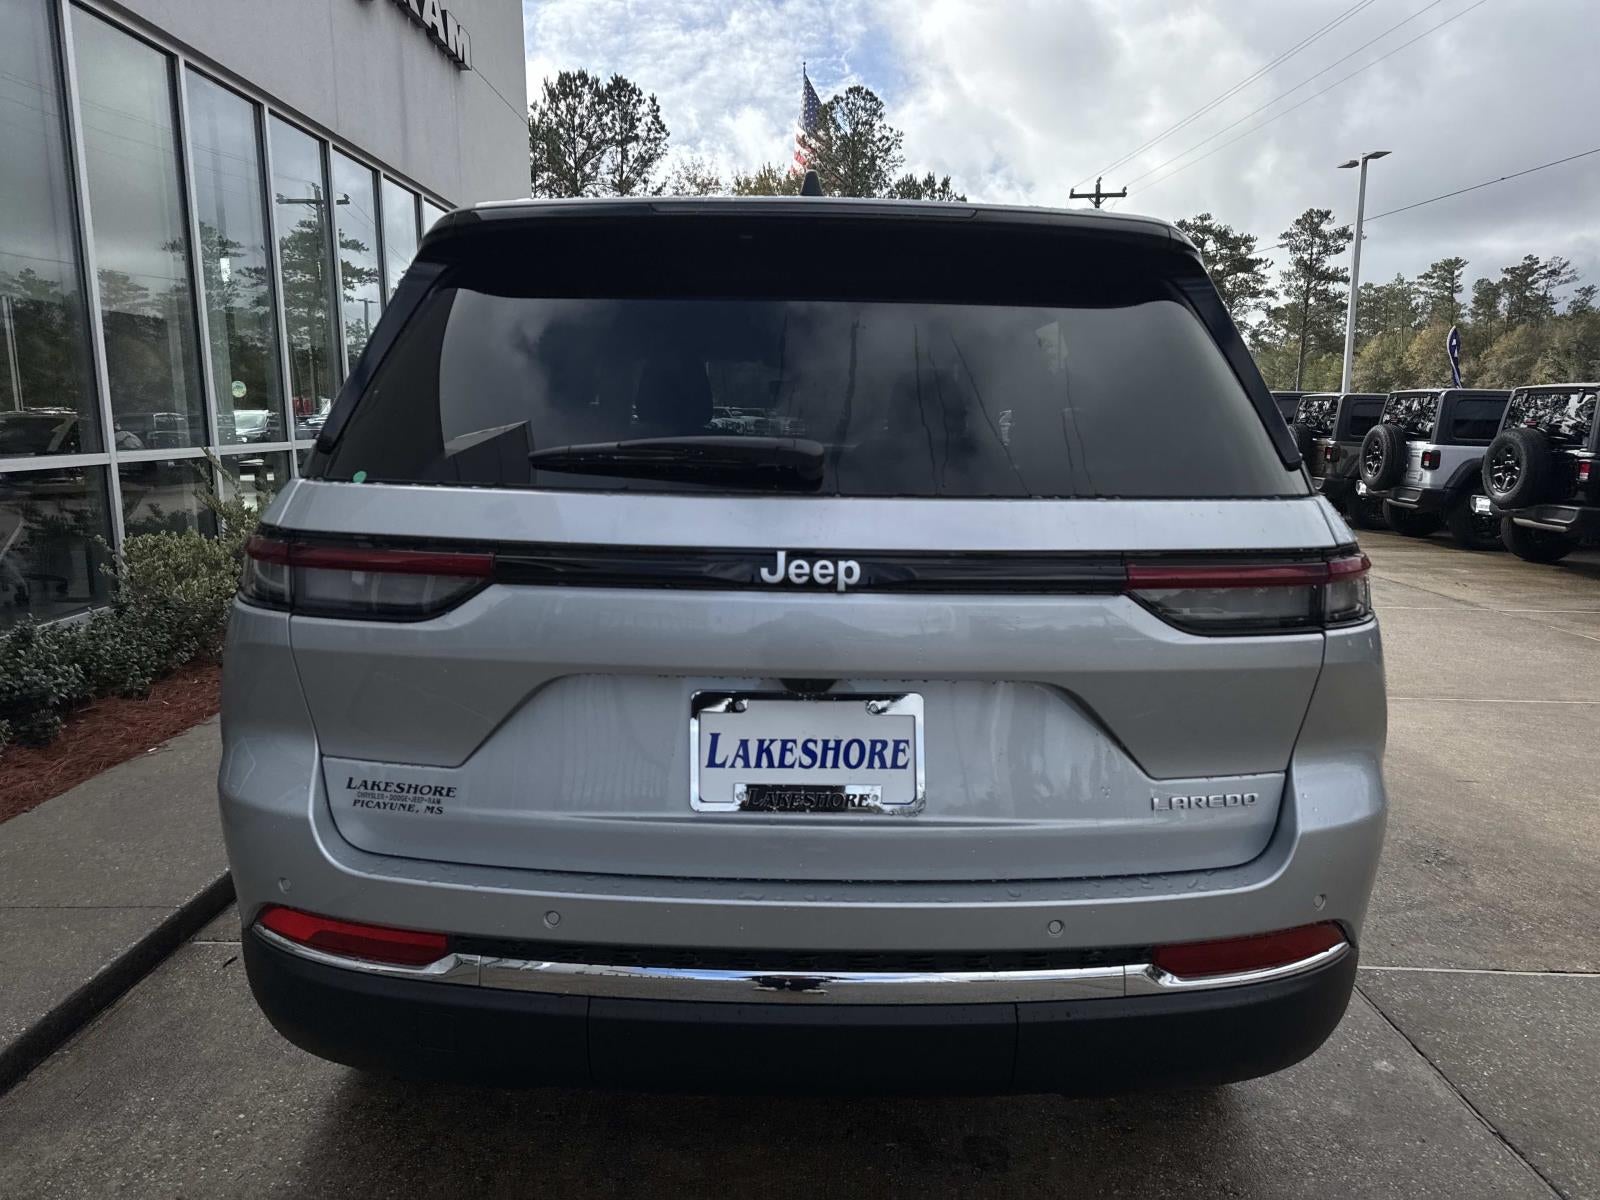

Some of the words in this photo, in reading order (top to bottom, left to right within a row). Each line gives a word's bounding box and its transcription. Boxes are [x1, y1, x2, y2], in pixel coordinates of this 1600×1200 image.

[402, 0, 472, 70] AM
[760, 550, 861, 592] Jeep
[705, 732, 910, 770] LAKESHORE
[346, 776, 457, 799] LAKESHORE
[1151, 792, 1258, 812] LAREDO
[352, 799, 420, 814] PICAYUNE,
[424, 805, 444, 816] MS
